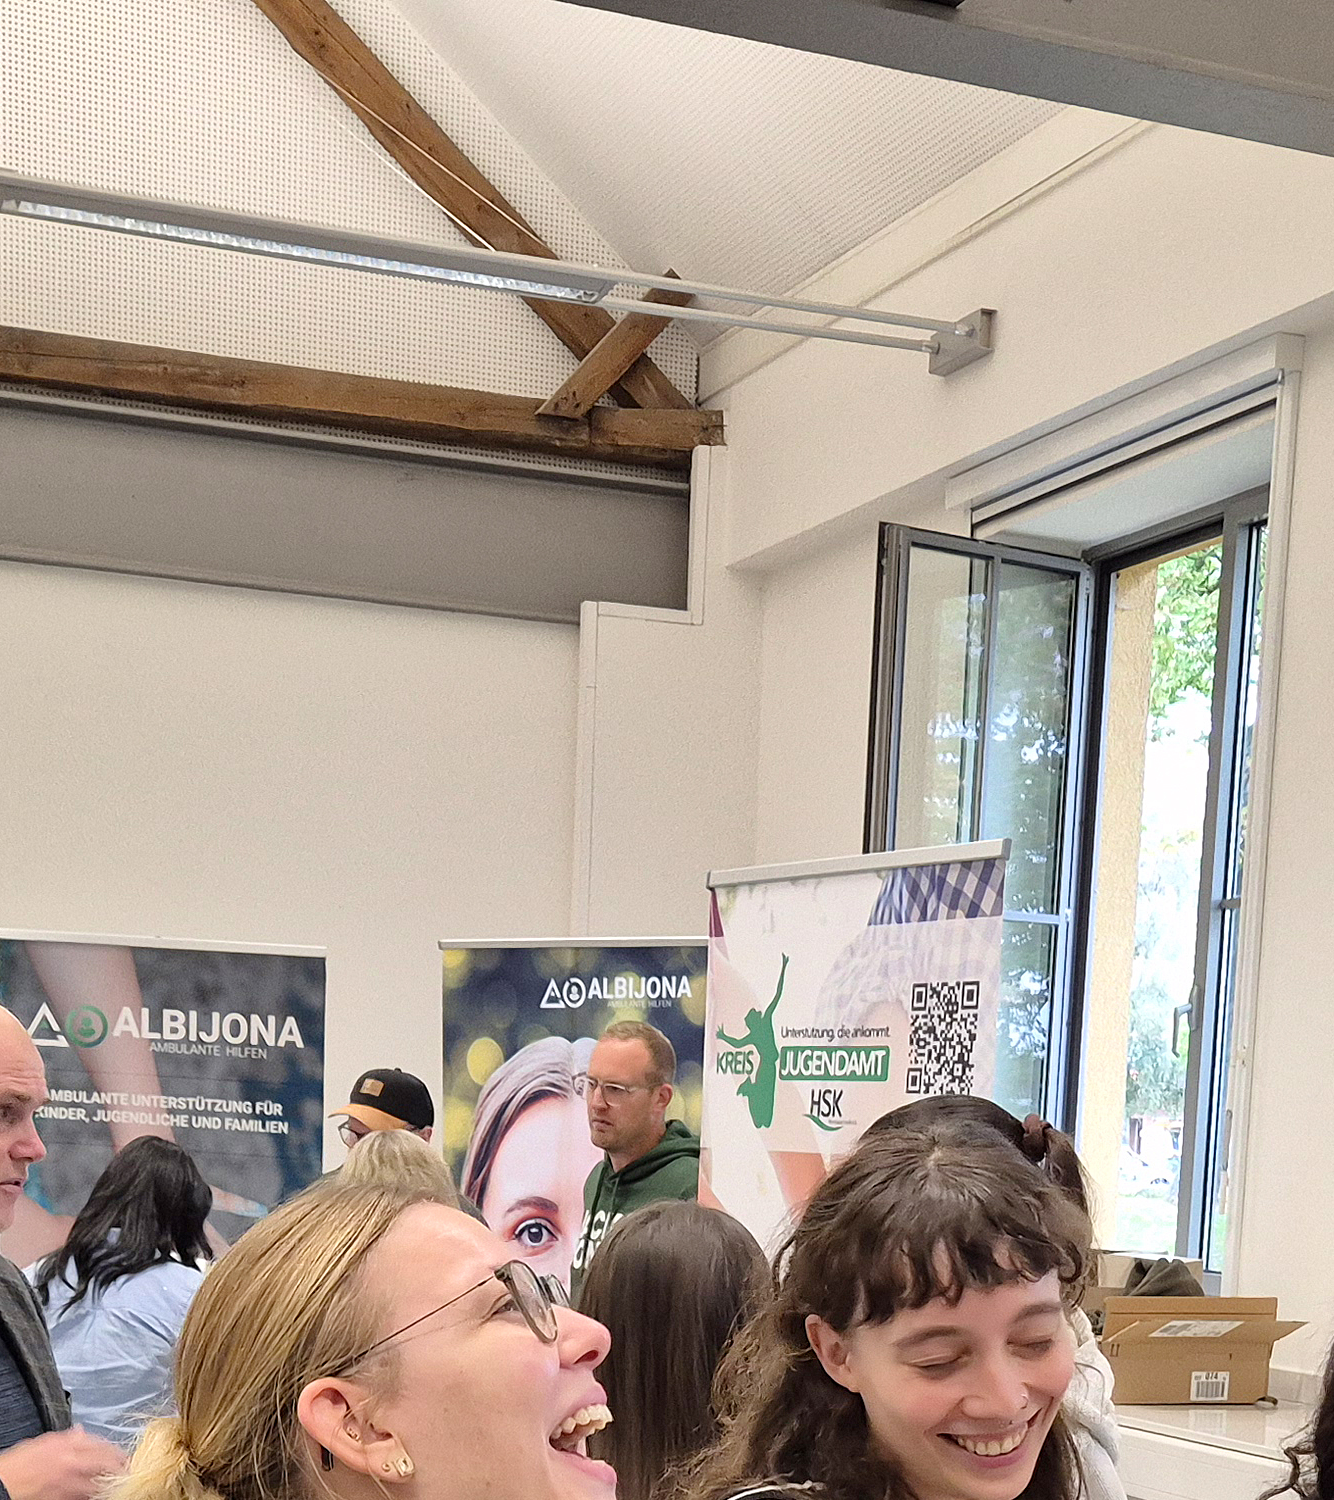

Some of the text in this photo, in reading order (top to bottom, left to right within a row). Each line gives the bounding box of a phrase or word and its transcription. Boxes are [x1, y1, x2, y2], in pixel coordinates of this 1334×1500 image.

[588, 975, 693, 999] ALBIJONA
[112, 1006, 305, 1049] ALBIJONA
[837, 1024, 851, 1038] die
[150, 1041, 268, 1059] AMBULANTE HILFEN
[717, 1050, 887, 1076] KREIS JUGENDAMT
[45, 1089, 283, 1116] MBULANTE UNTERSTÜTZUNG FÜR
[810, 1089, 843, 1117] HSK
[92, 1109, 189, 1128] JUGENDLICHE
[192, 1115, 222, 1130] UND
[225, 1117, 289, 1134] FAMILIEN
